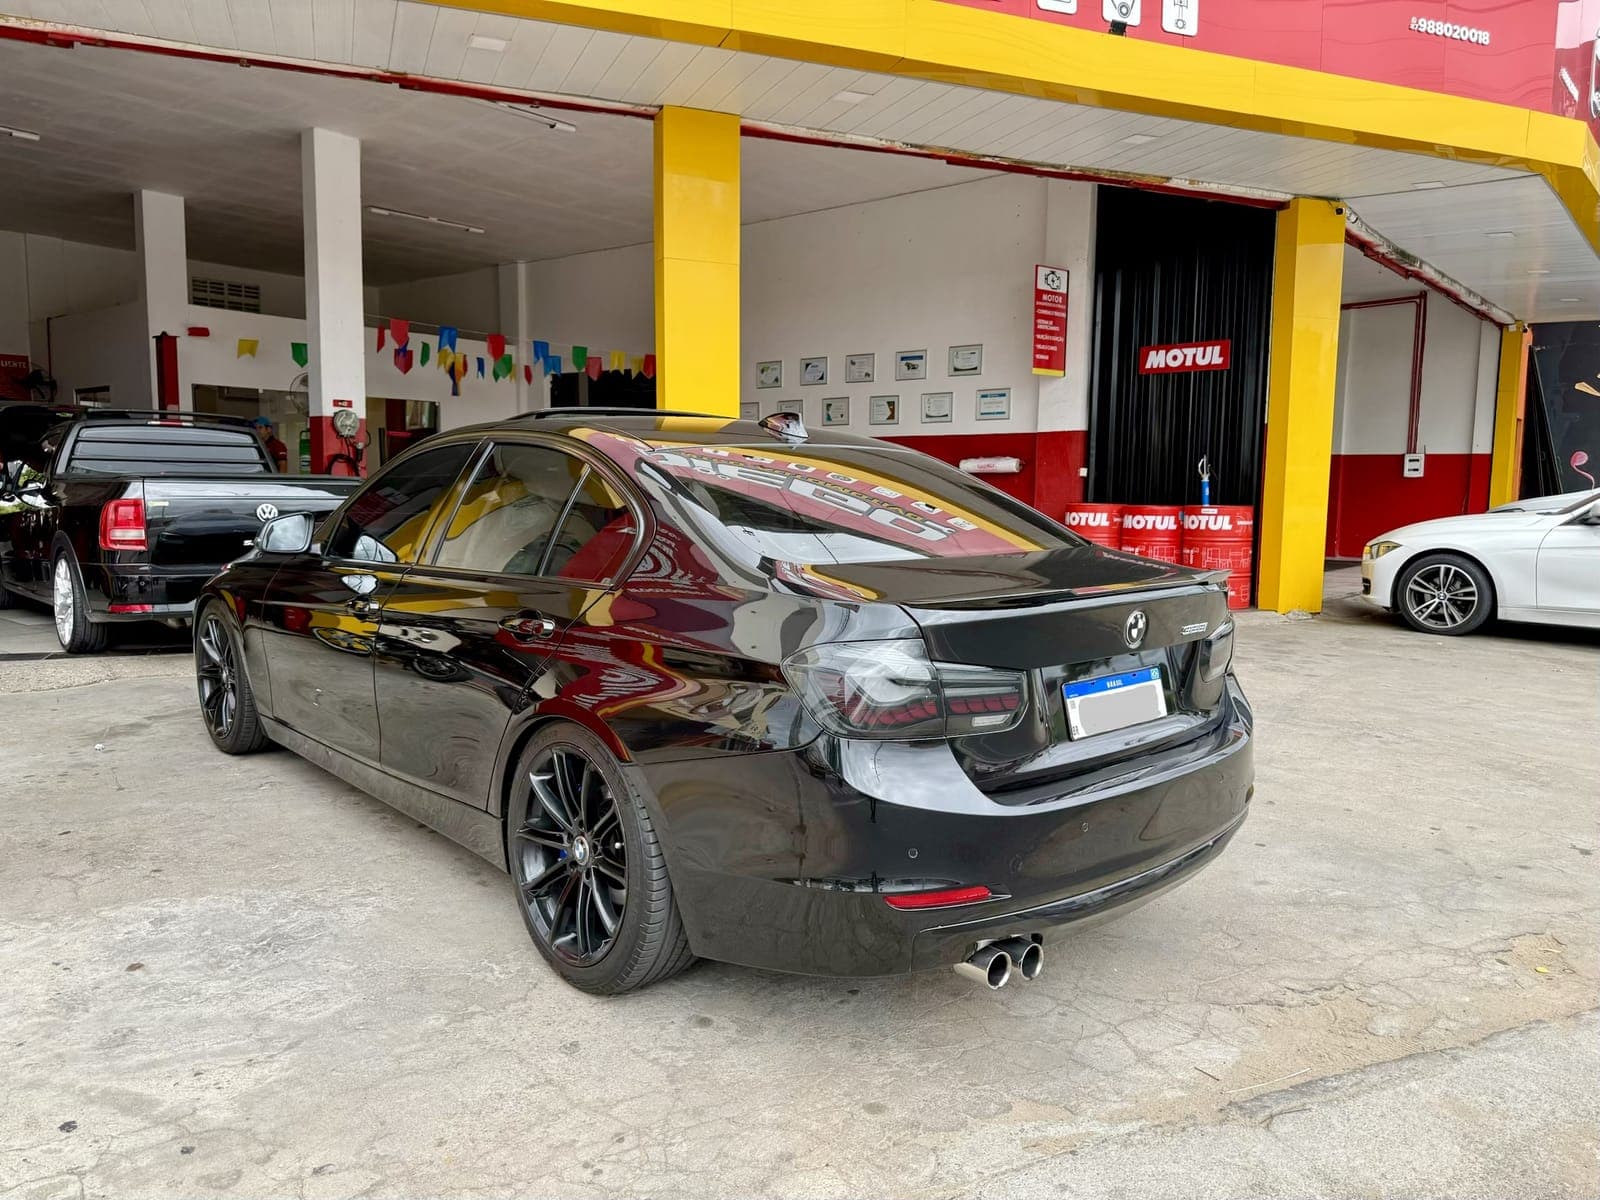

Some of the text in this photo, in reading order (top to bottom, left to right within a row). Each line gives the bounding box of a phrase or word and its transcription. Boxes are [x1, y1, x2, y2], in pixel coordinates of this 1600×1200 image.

[1418, 17, 1490, 45] 988020018
[1144, 345, 1224, 369] MOTUL
[1123, 515, 1177, 530] MOTUL
